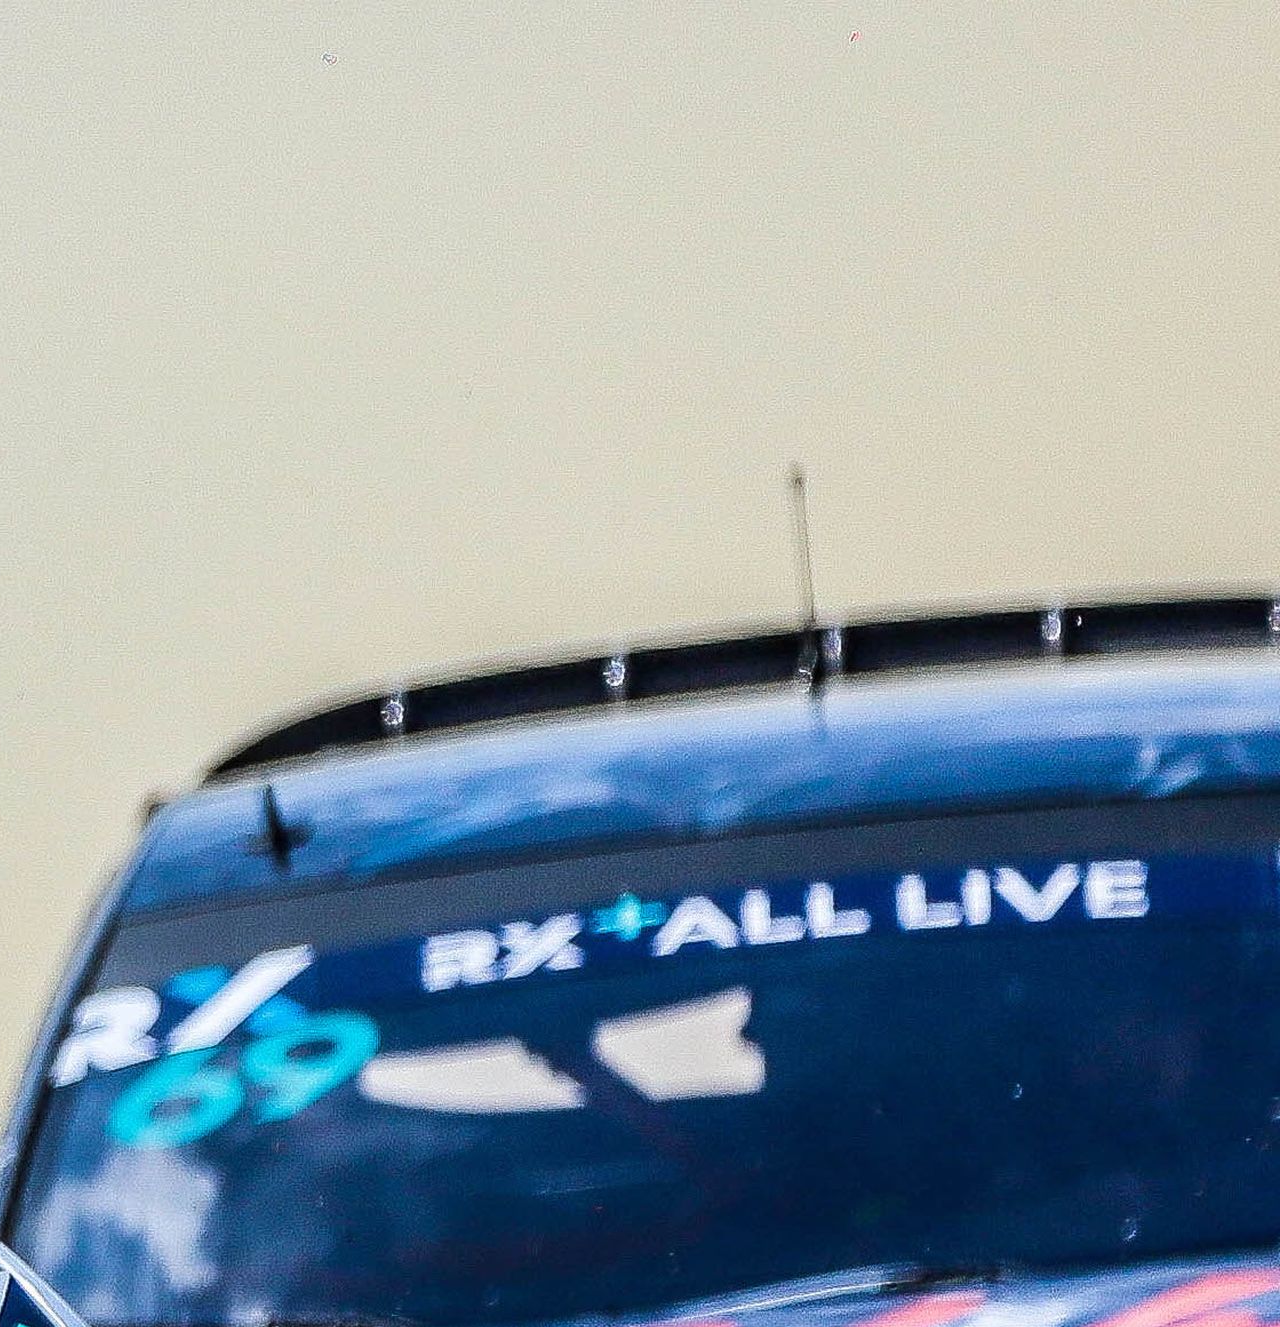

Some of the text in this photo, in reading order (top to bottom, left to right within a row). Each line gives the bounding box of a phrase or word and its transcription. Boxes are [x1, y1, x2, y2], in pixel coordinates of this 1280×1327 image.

[894, 858, 1151, 933] LIVE
[51, 940, 308, 1088] RX
[108, 1005, 380, 1149] 69
